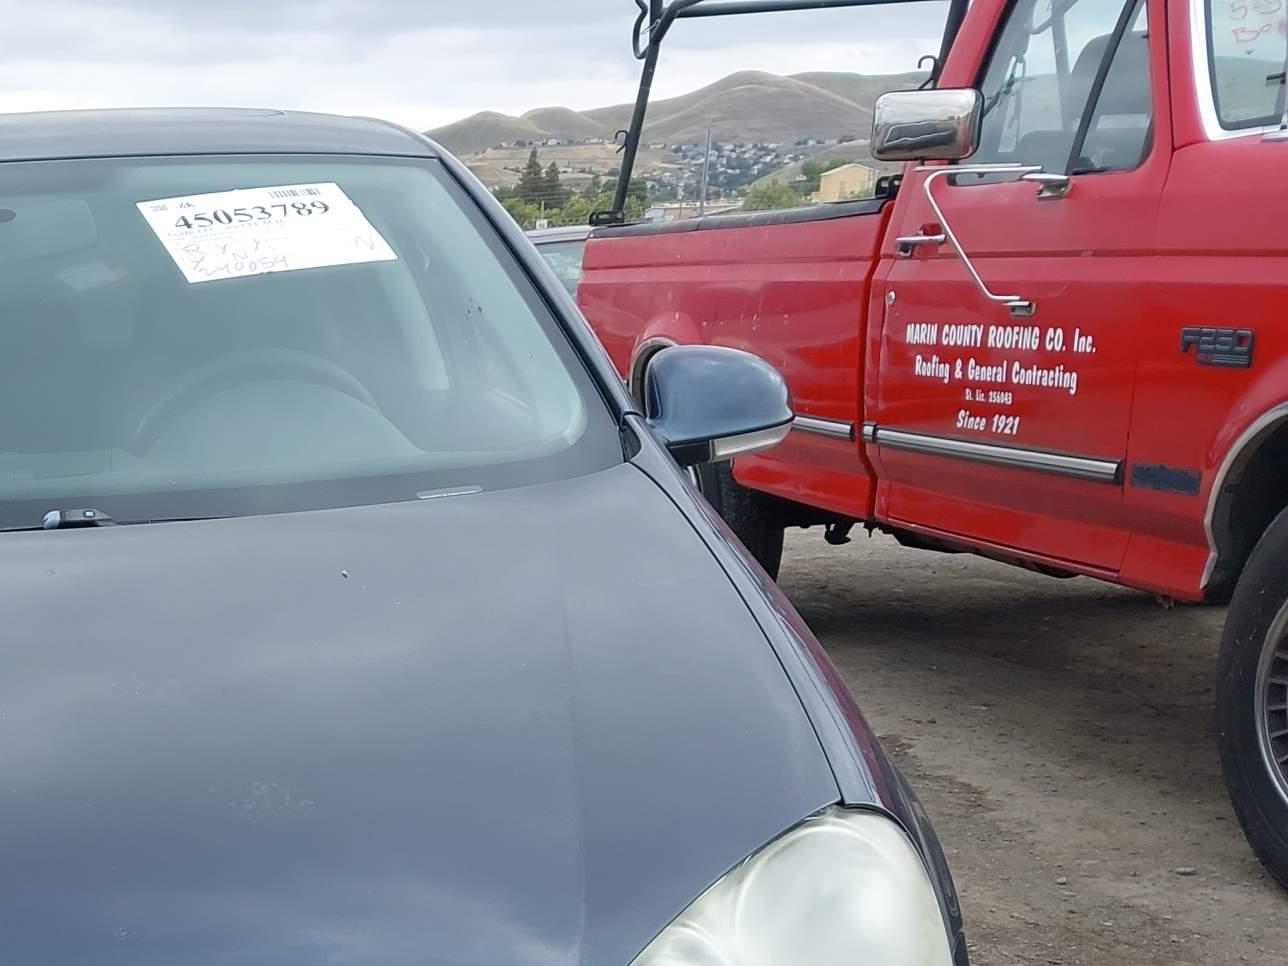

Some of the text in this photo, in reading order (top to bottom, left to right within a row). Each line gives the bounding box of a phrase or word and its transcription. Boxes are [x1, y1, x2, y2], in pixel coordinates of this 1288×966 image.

[174, 200, 330, 230] 45053789
[906, 323, 1096, 353] MARIN COUNTY ROOFING CO. Inc.
[915, 354, 1078, 396] Roofing & General Contracting
[956, 408, 1020, 436] Since 1921
